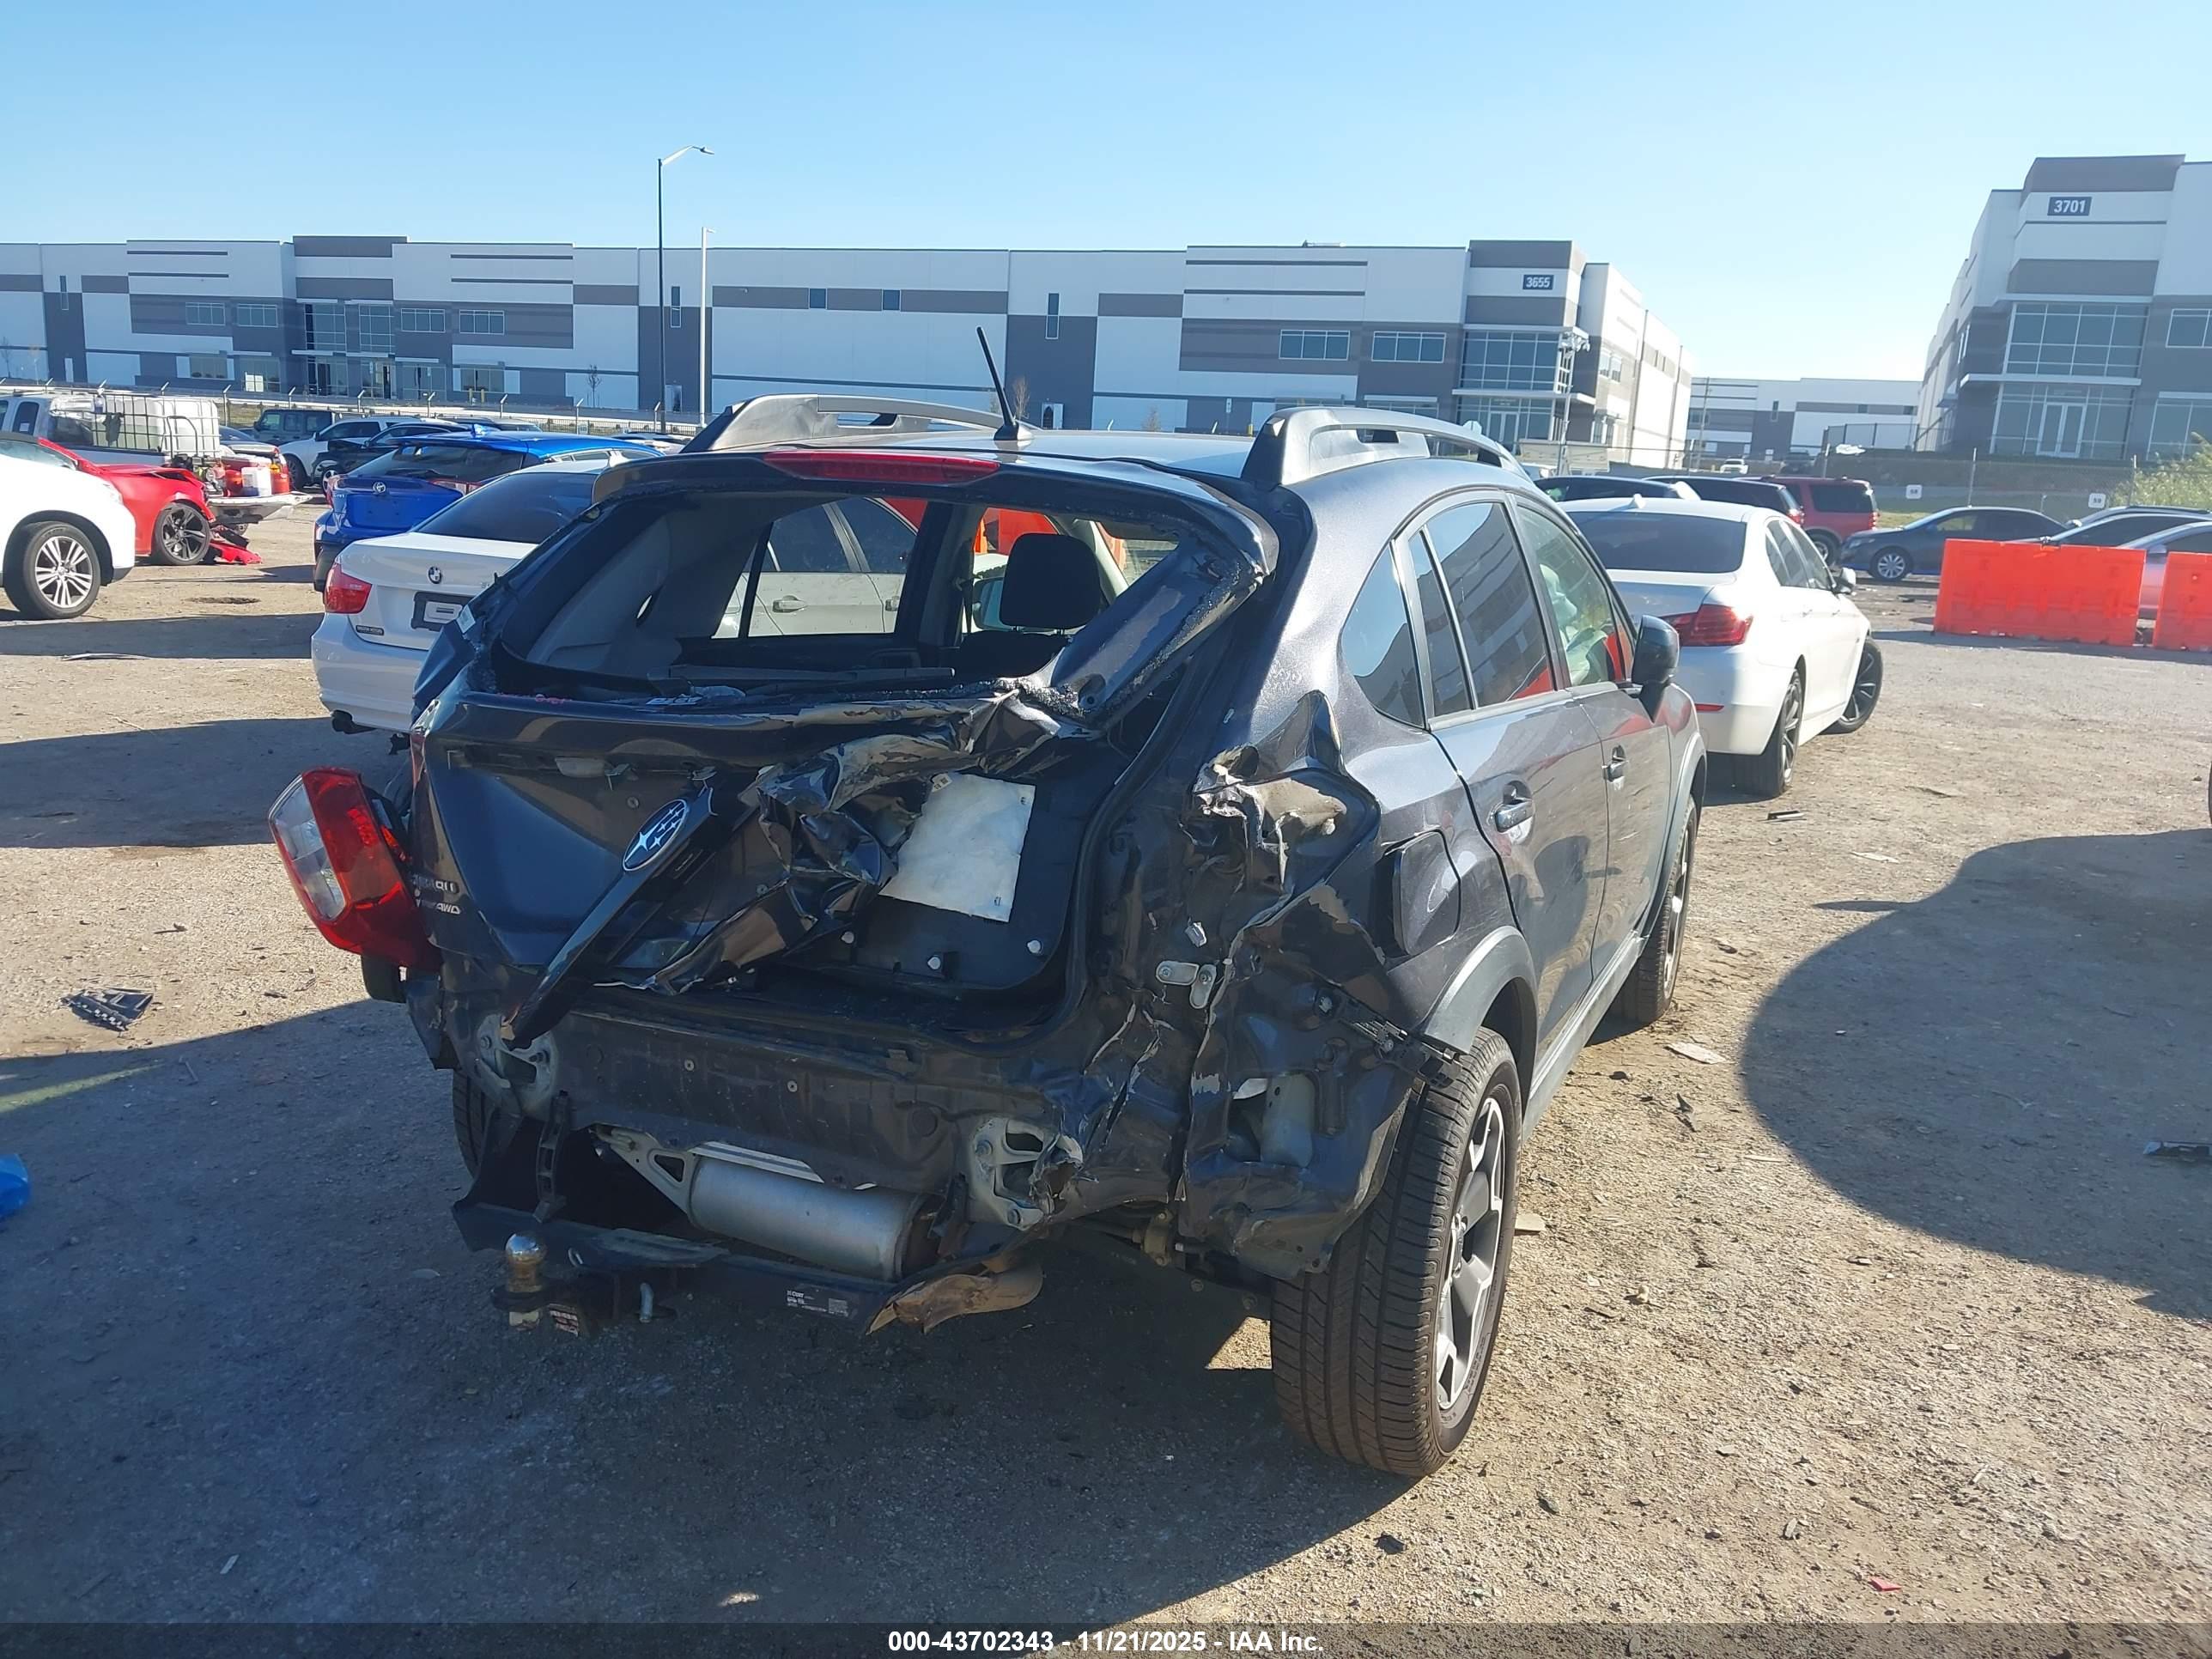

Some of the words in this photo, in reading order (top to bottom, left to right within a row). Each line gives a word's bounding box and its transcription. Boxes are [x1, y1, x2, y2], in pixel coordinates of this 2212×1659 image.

[2053, 199, 2086, 213] 3701
[1526, 276, 1550, 288] 3655
[436, 902, 461, 915] AWD
